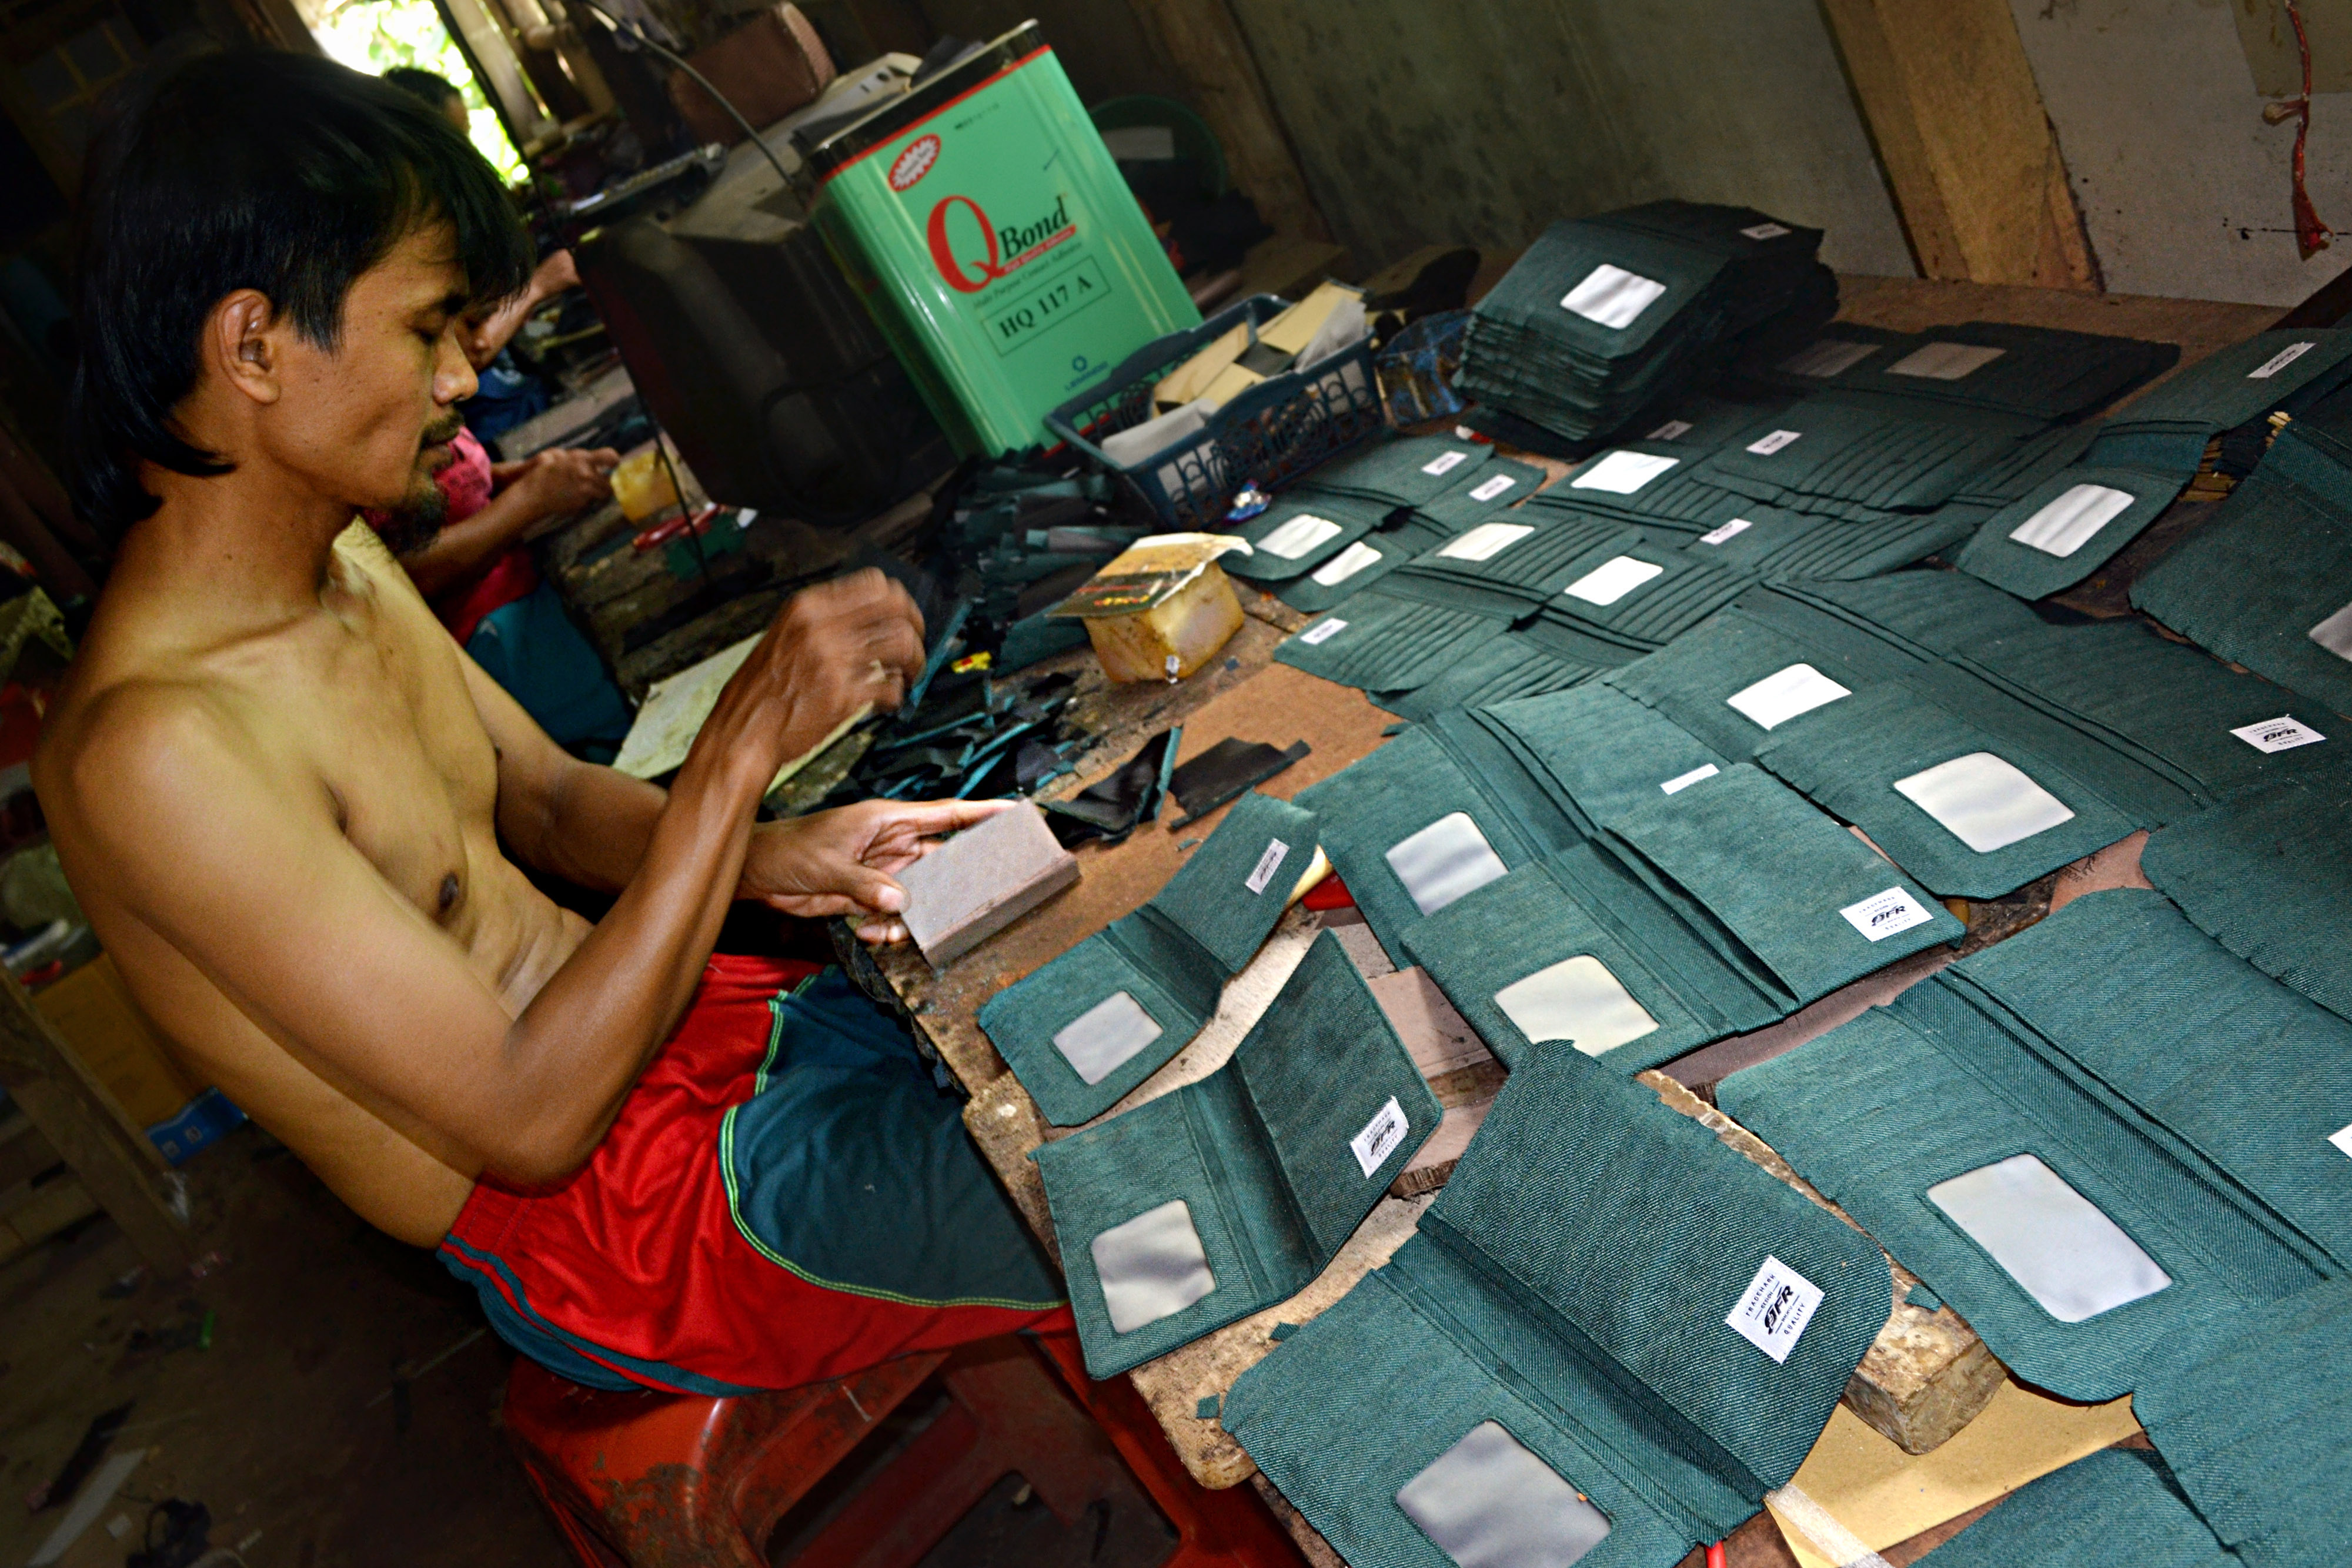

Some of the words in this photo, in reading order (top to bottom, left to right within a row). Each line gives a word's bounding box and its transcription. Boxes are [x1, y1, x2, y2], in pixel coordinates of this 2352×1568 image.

[999, 195, 1070, 260] Bond
[999, 308, 1036, 337] HQ
[1038, 284, 1068, 315] 117
[1077, 275, 1093, 293] A
[1784, 1302, 1806, 1335] QUALITY
